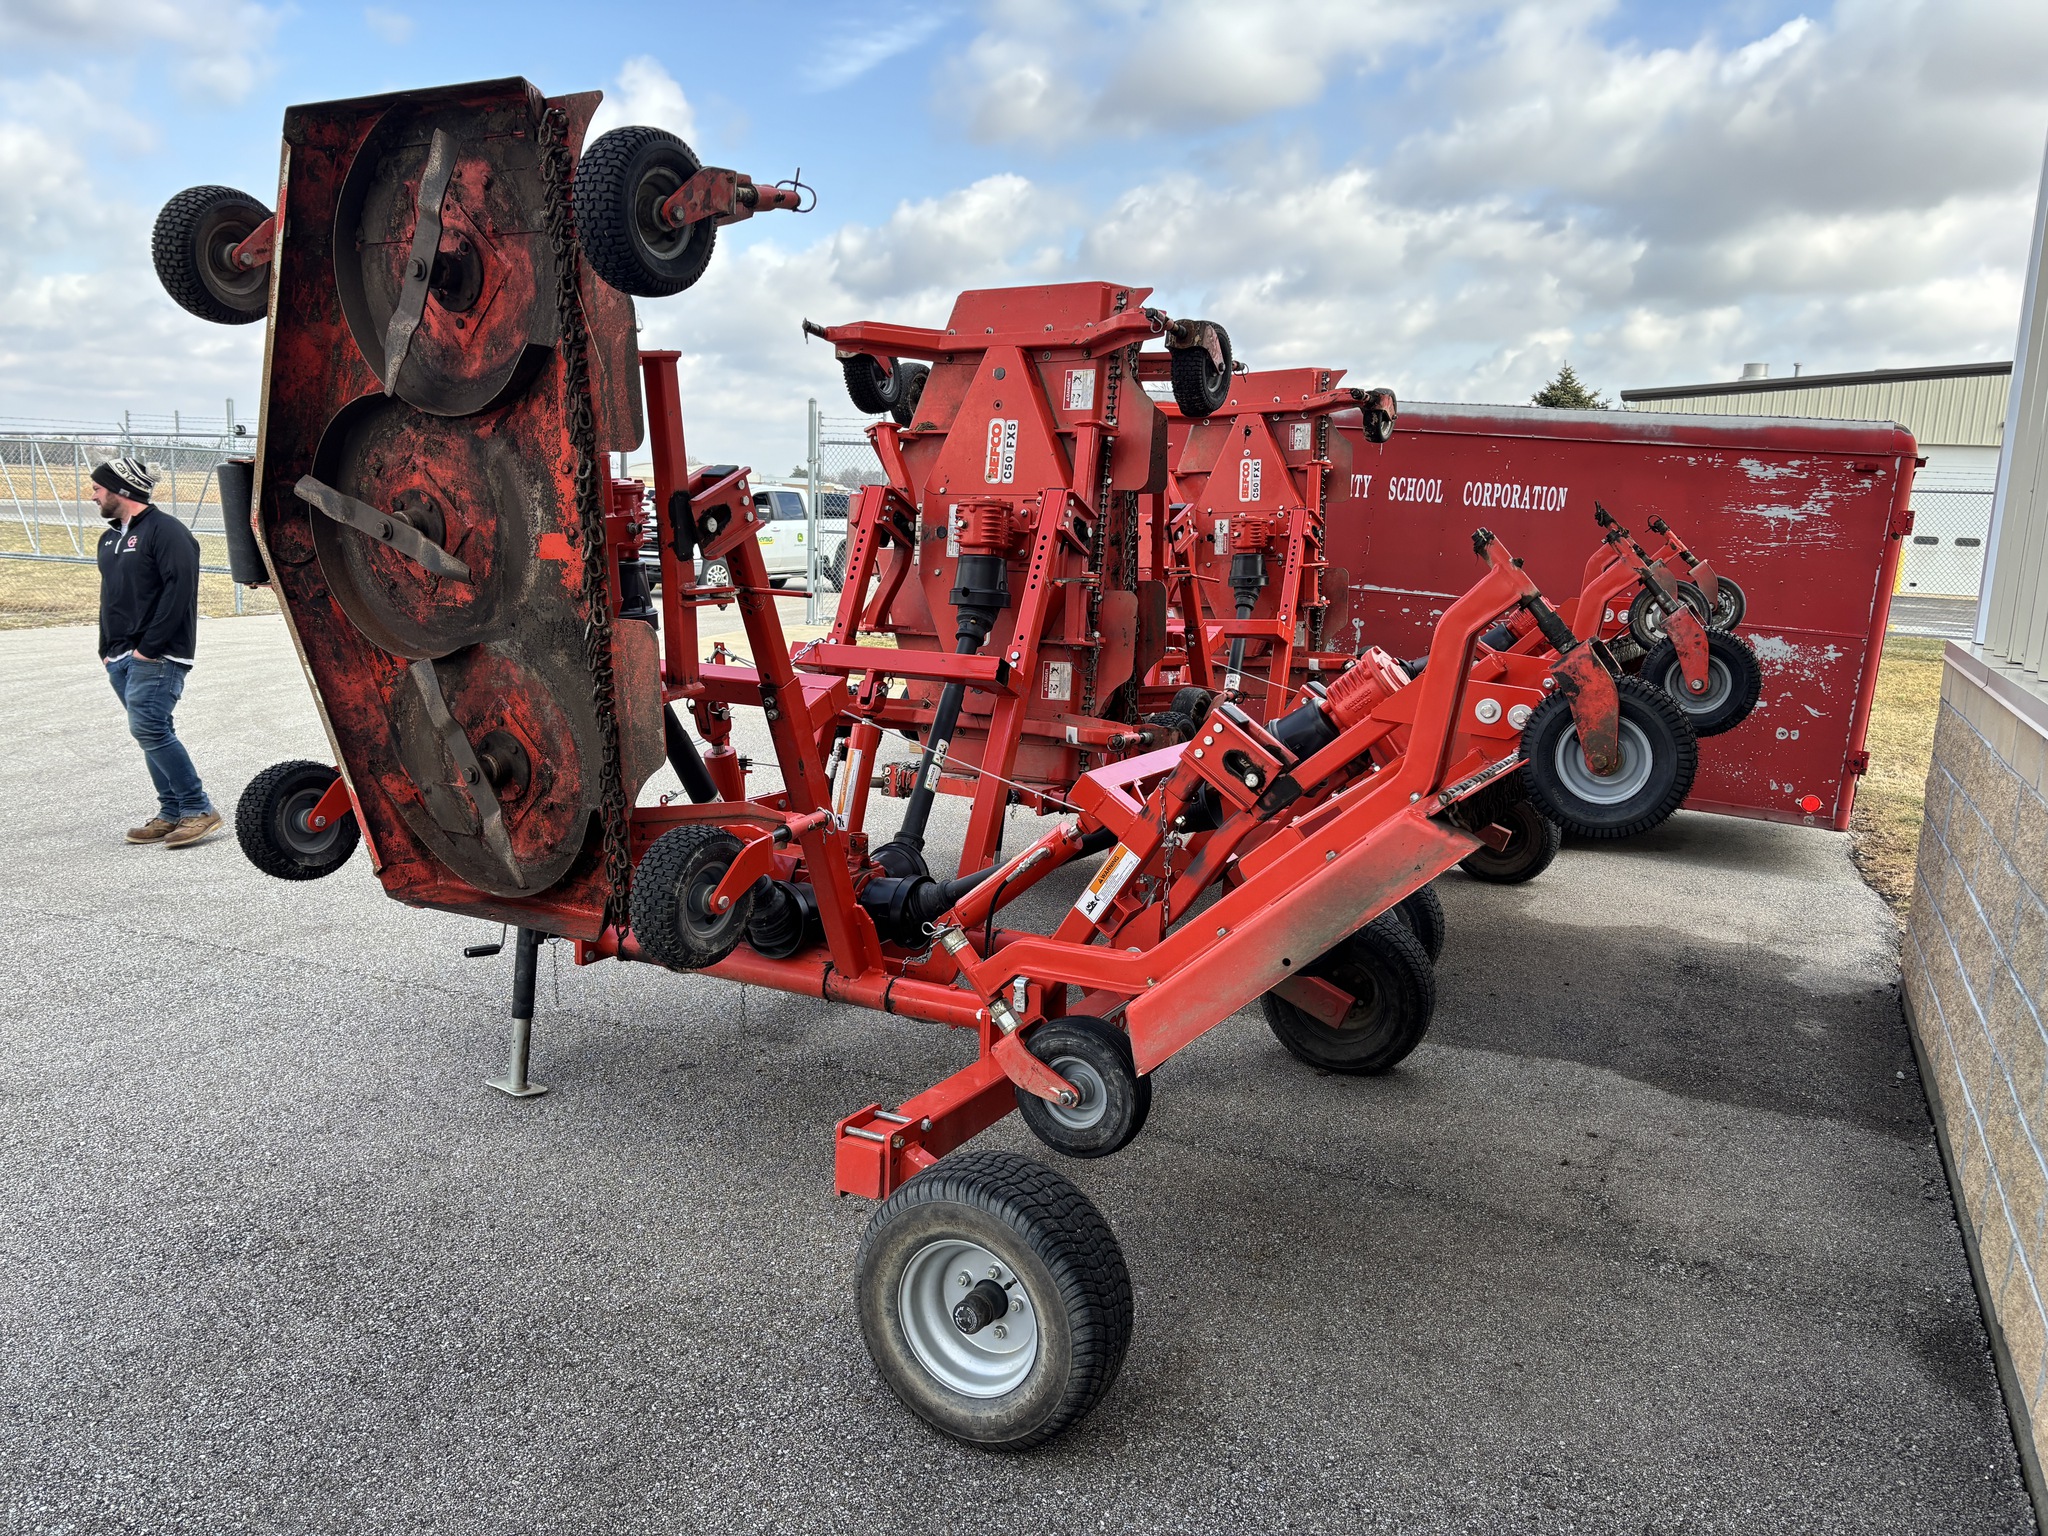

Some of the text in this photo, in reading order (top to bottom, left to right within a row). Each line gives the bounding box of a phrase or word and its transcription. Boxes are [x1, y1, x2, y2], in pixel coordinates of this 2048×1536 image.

[988, 423, 1002, 479] BEFCO
[1003, 423, 1016, 479] C50 FX5
[1242, 462, 1250, 498] BEFCO
[1252, 482, 1260, 498] C50
[1388, 476, 1443, 503] SCHOOL
[1463, 481, 1568, 511] CORPORATION
[1102, 855, 1120, 880] WARNING
